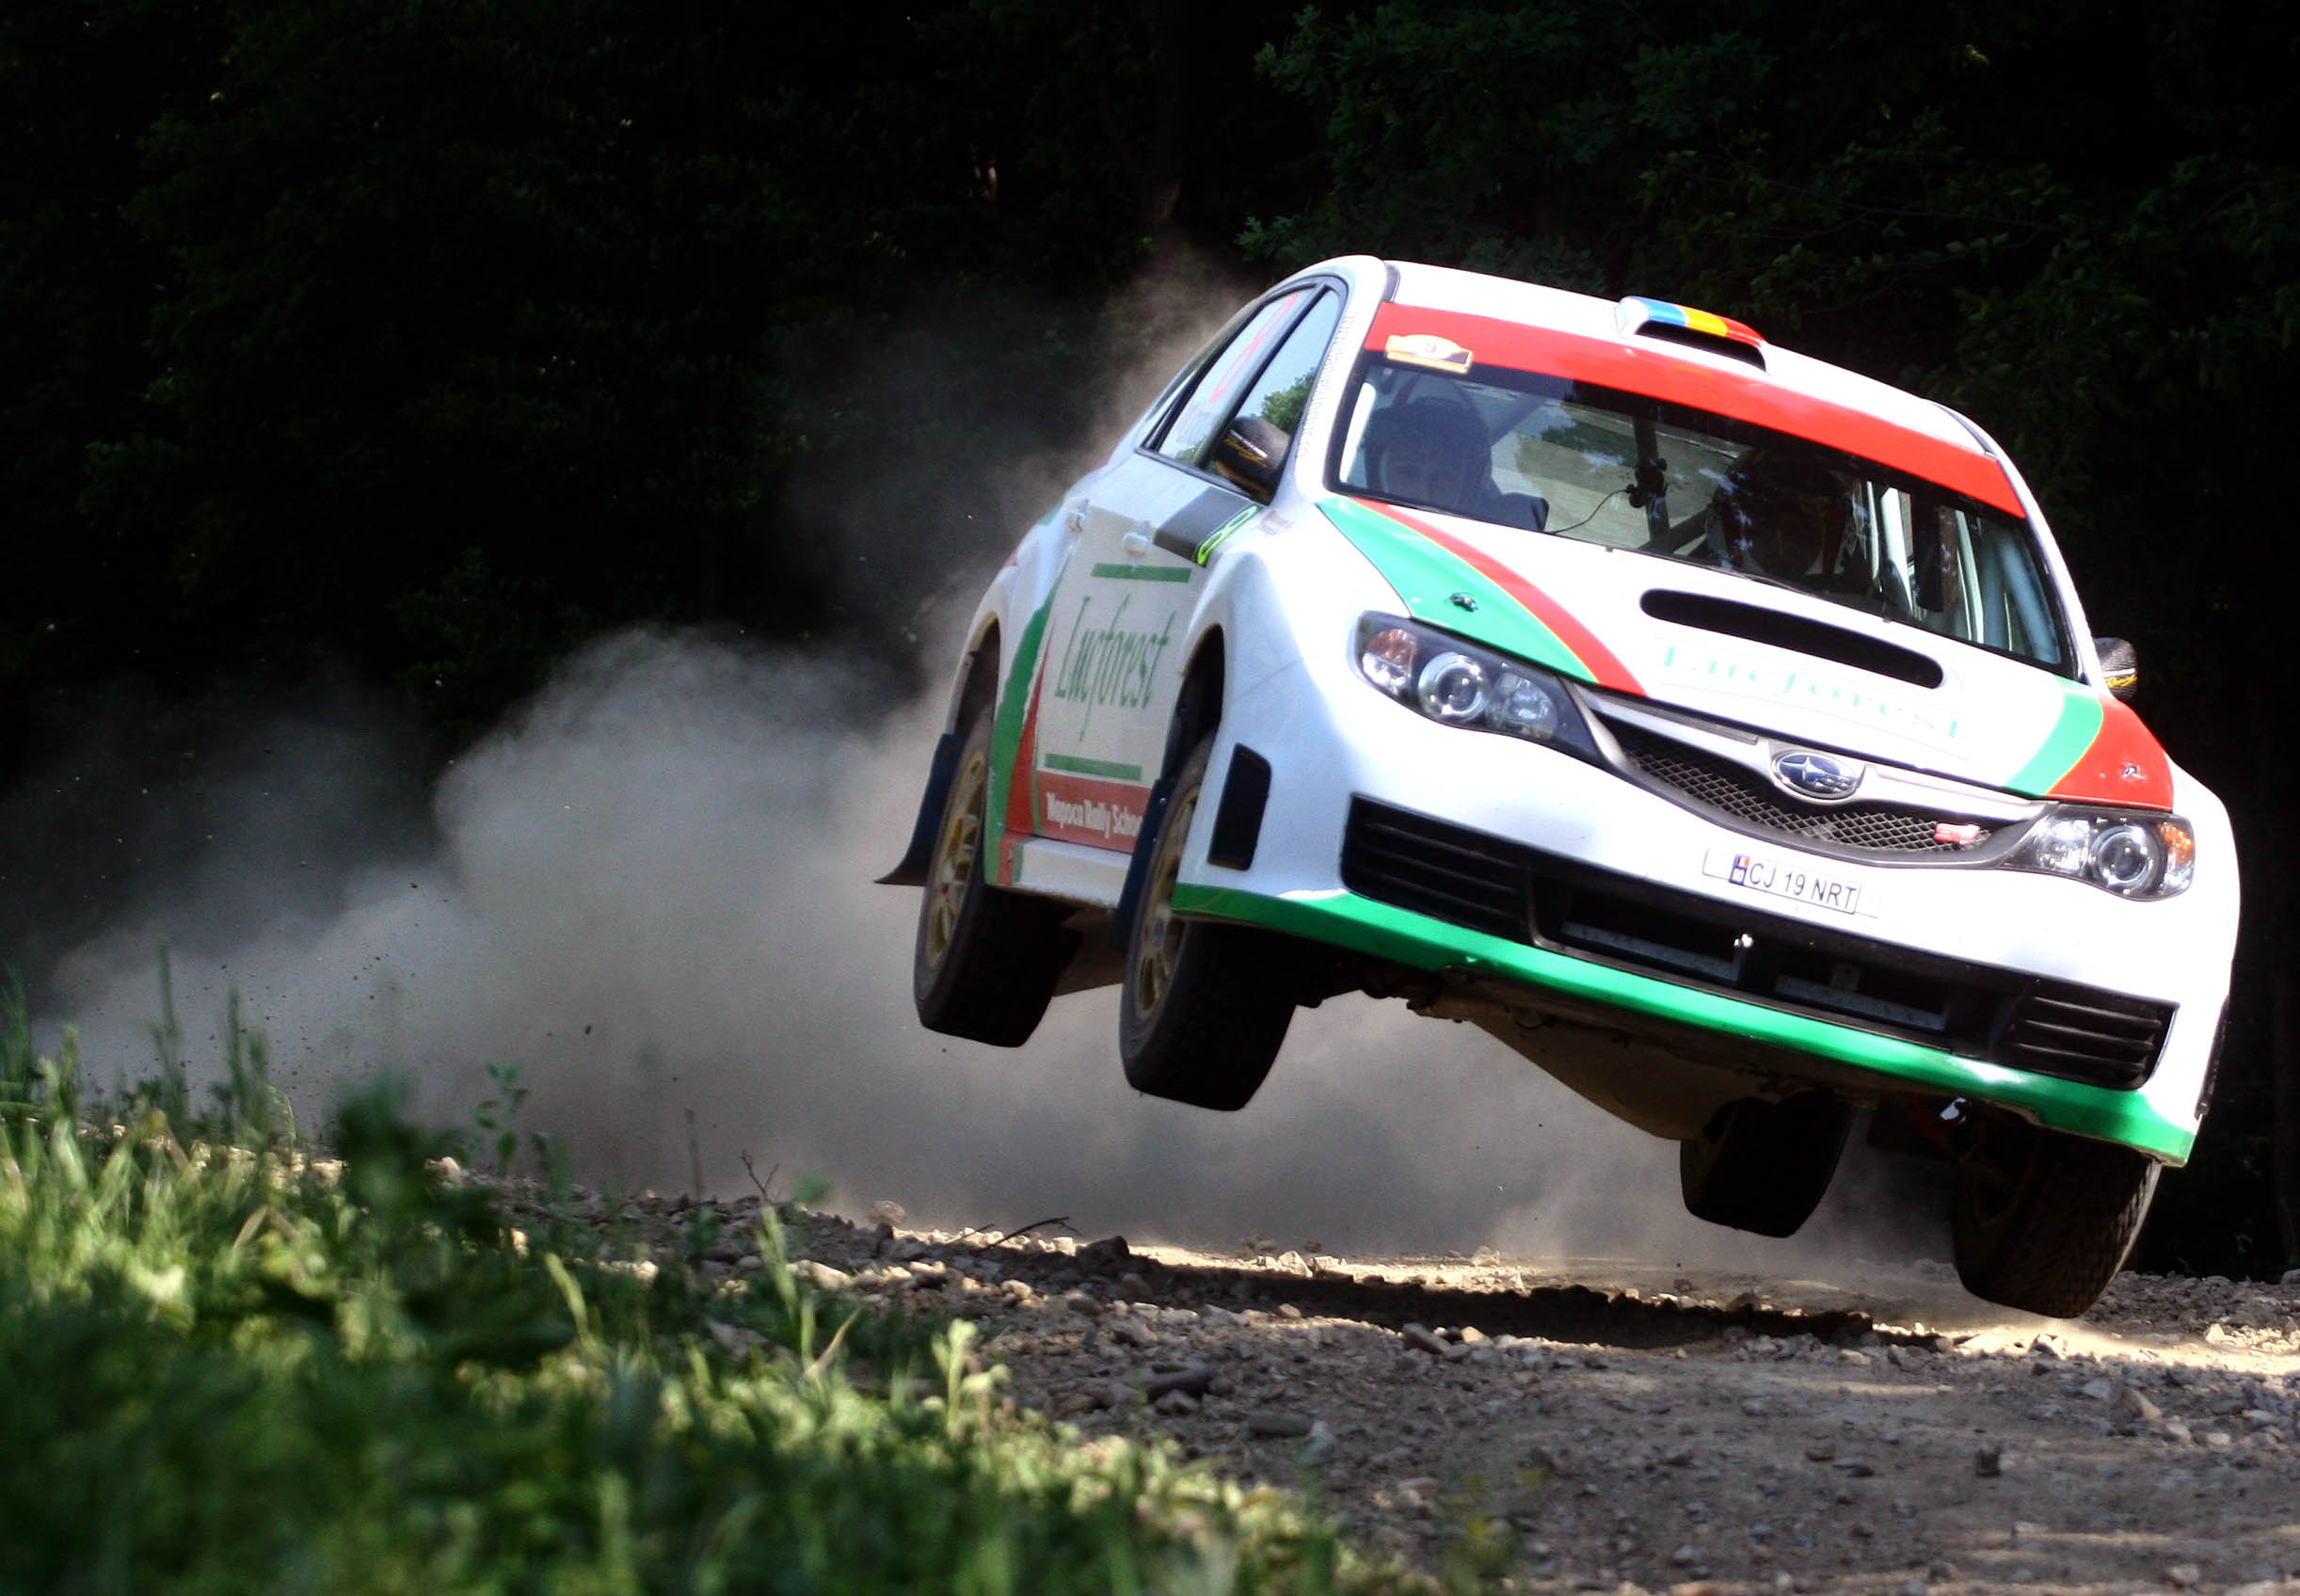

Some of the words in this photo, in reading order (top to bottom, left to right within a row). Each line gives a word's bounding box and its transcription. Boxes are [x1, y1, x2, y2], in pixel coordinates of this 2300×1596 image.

[1054, 592, 1174, 742] Lucforest
[1084, 799, 1110, 839] Rally
[1749, 863, 1777, 888] CJ
[1785, 870, 1806, 896] 19
[1811, 878, 1857, 909] NRT
